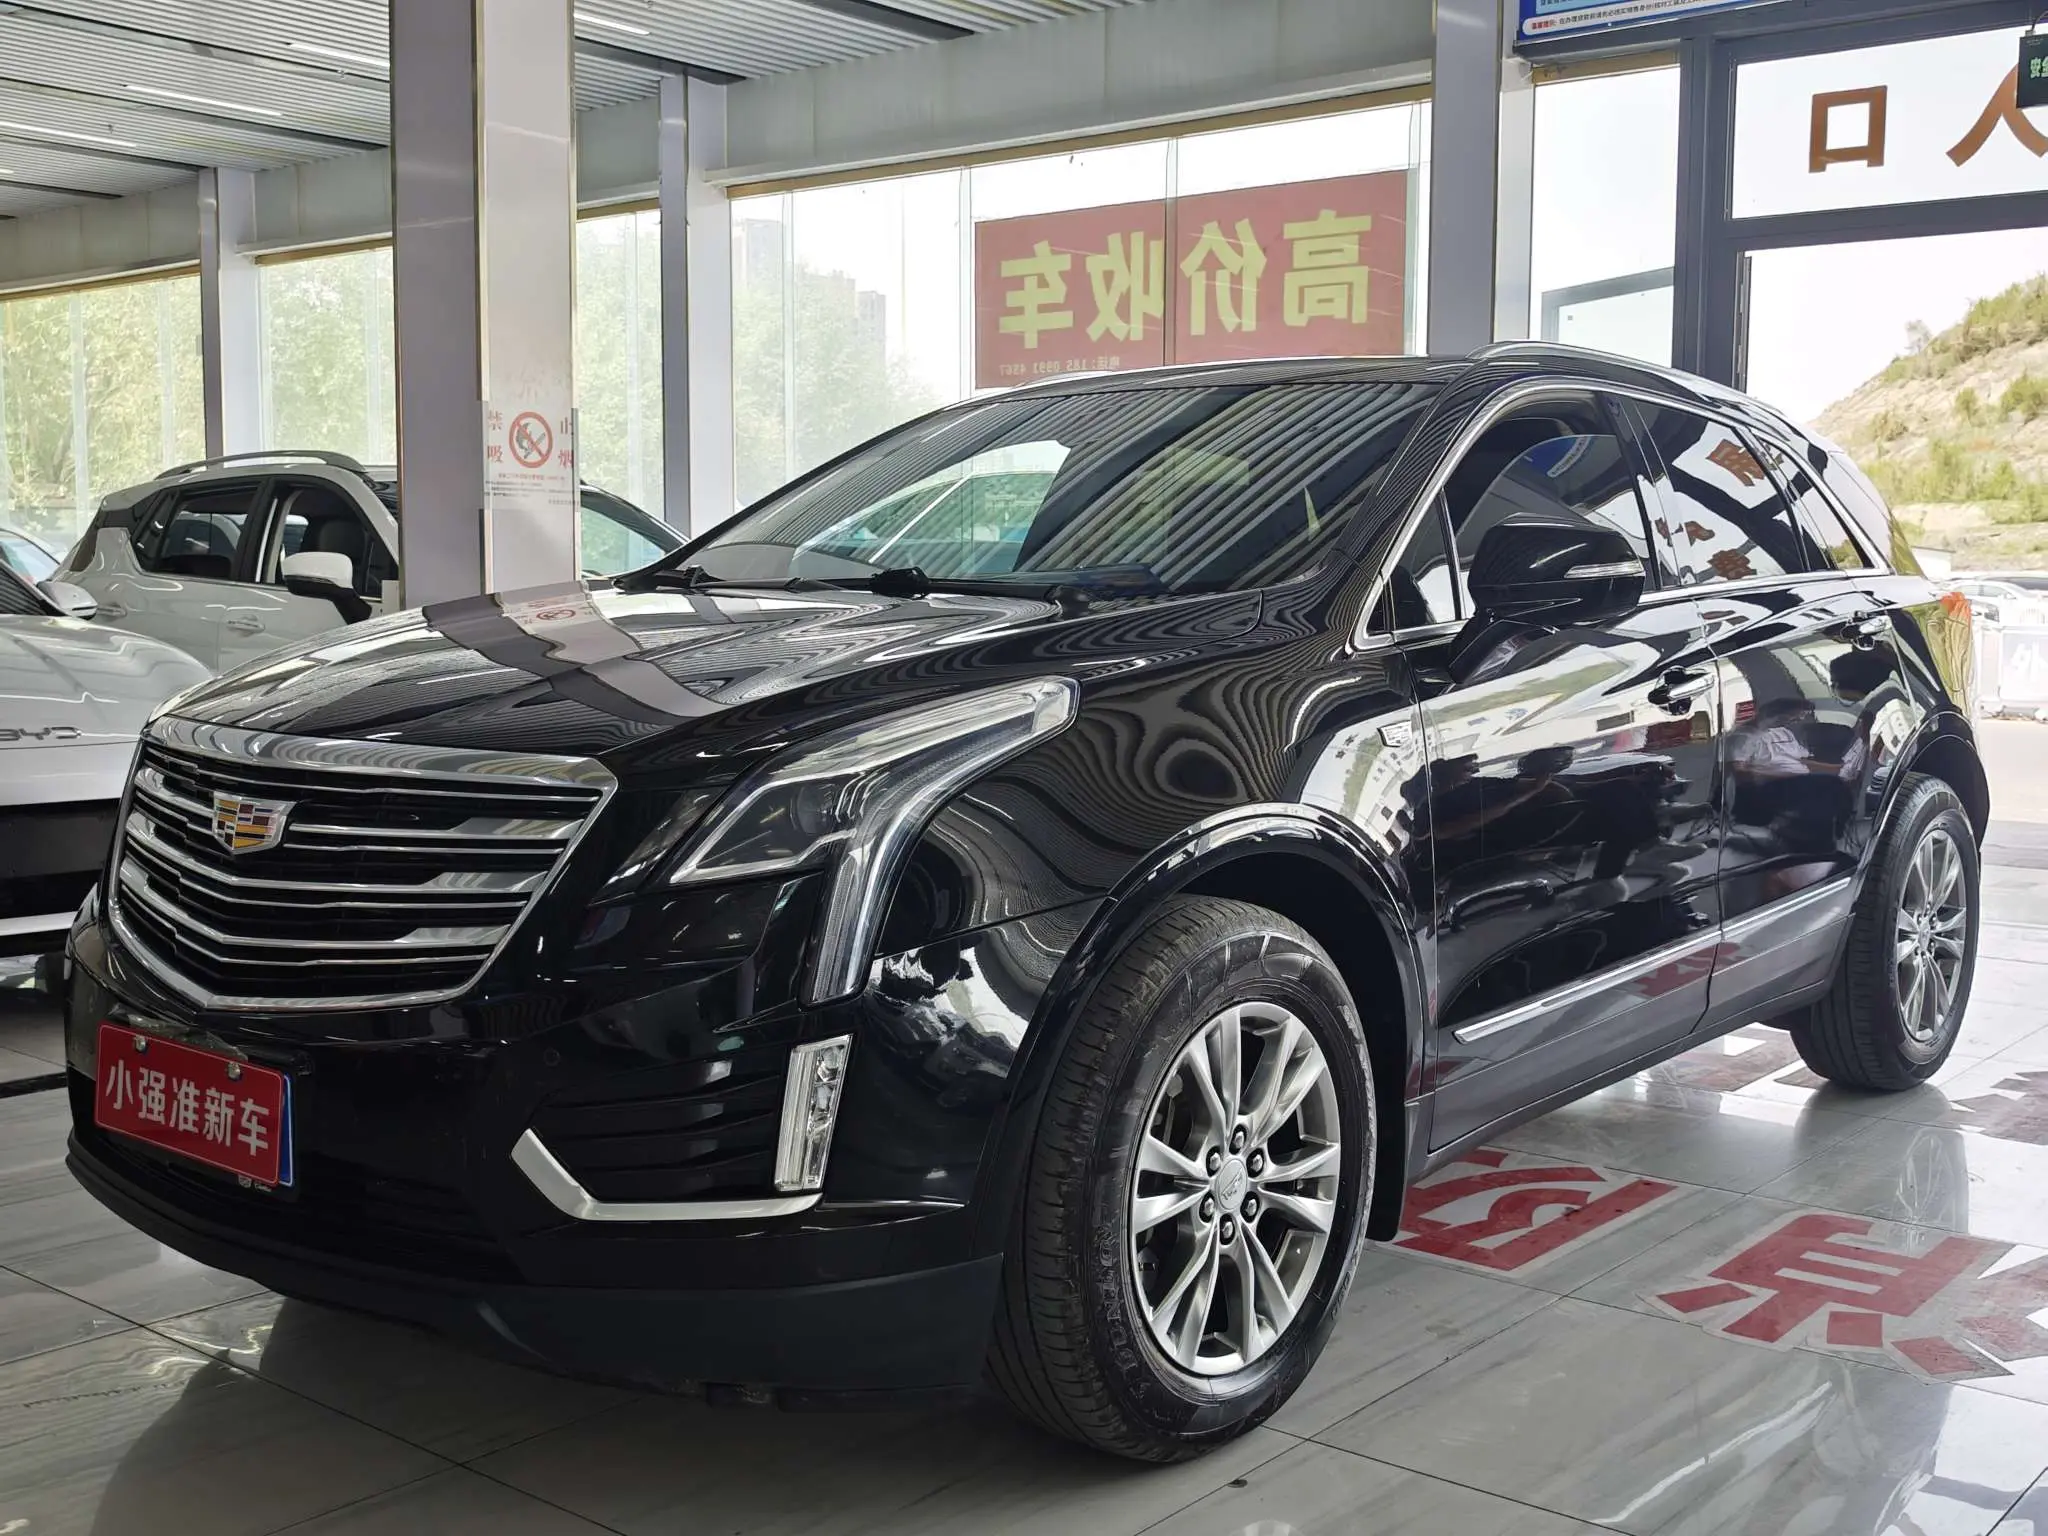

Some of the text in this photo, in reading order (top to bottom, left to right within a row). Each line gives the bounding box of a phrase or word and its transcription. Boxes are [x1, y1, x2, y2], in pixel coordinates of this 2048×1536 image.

[105, 1059, 269, 1157] 小强准新车
